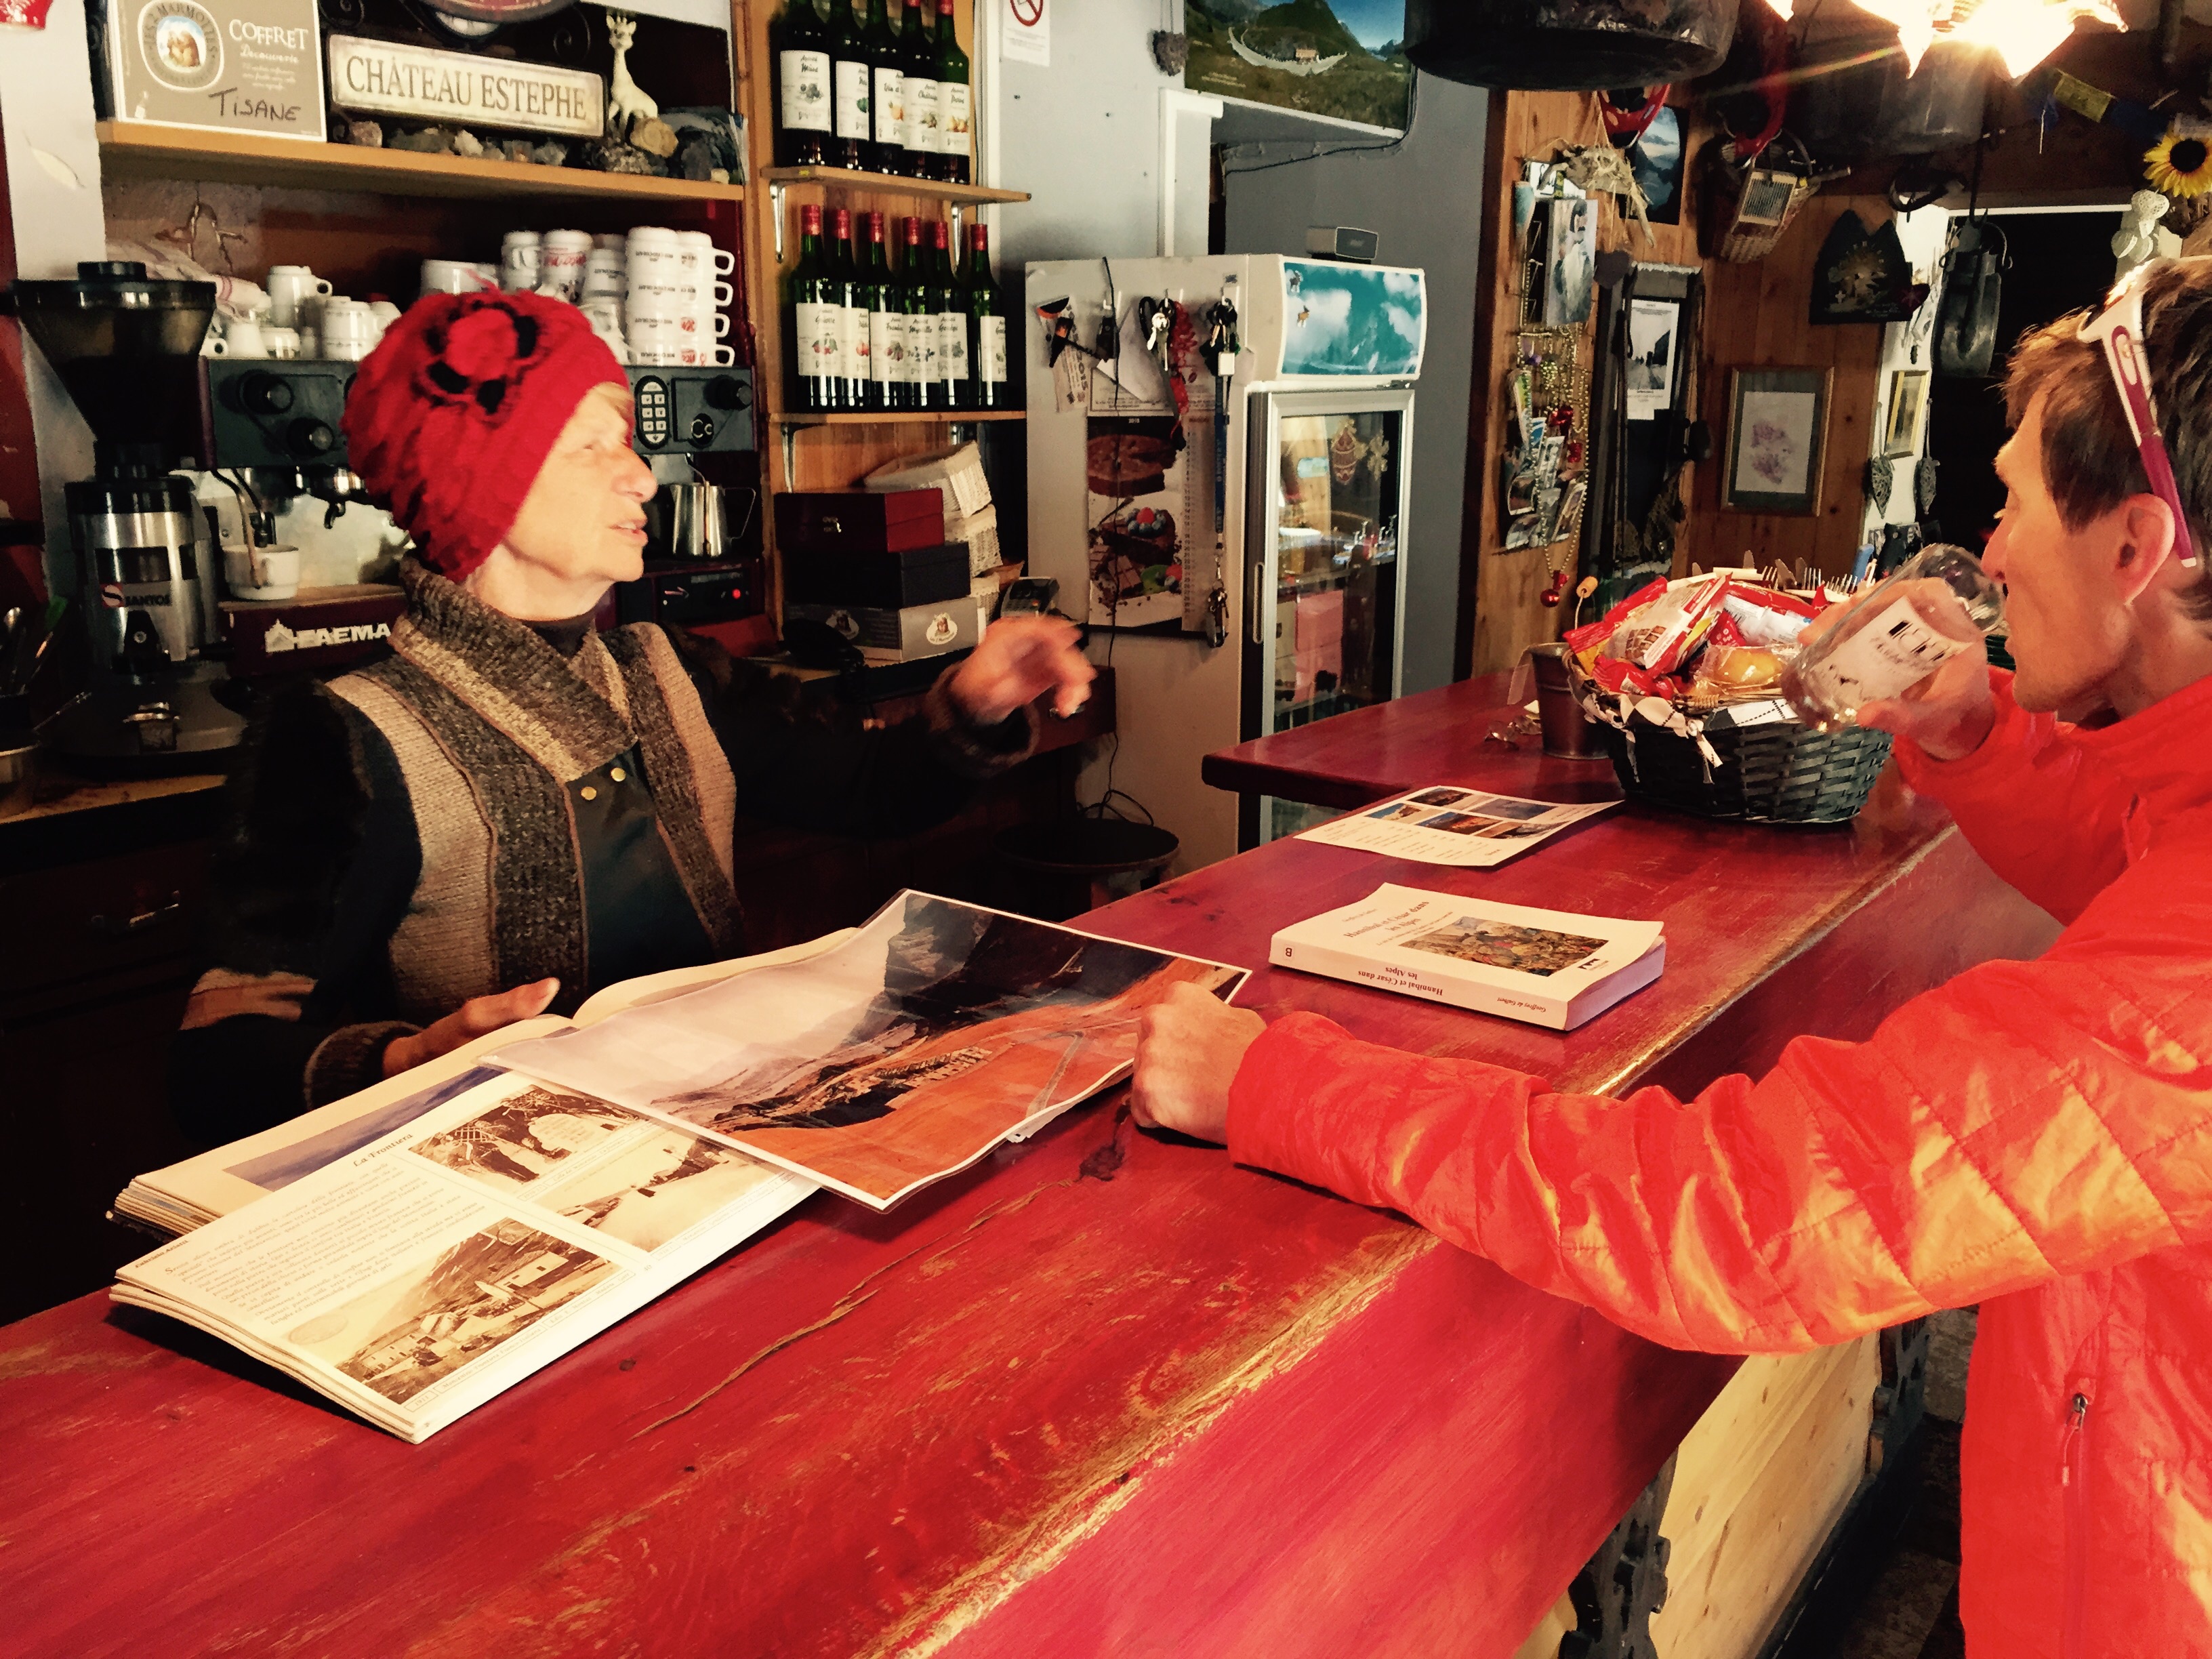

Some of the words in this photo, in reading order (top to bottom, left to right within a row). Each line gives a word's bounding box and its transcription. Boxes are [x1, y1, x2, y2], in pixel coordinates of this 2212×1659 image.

[228, 19, 309, 49] COFFRET
[480, 73, 588, 121] ESTEPHE
[125, 594, 172, 607] SANTOS
[295, 622, 392, 650] FAEMA
[1409, 900, 1430, 914] dans
[1285, 947, 1293, 958] B
[1357, 970, 1375, 981] dans
[1385, 966, 1406, 978] Alpes
[1407, 971, 1418, 981] les
[1376, 974, 1398, 988] César
[1399, 979, 1408, 987] et
[1409, 981, 1443, 996] Hannibal
[352, 1155, 368, 1167] La
[367, 1132, 413, 1159] Frontiera
